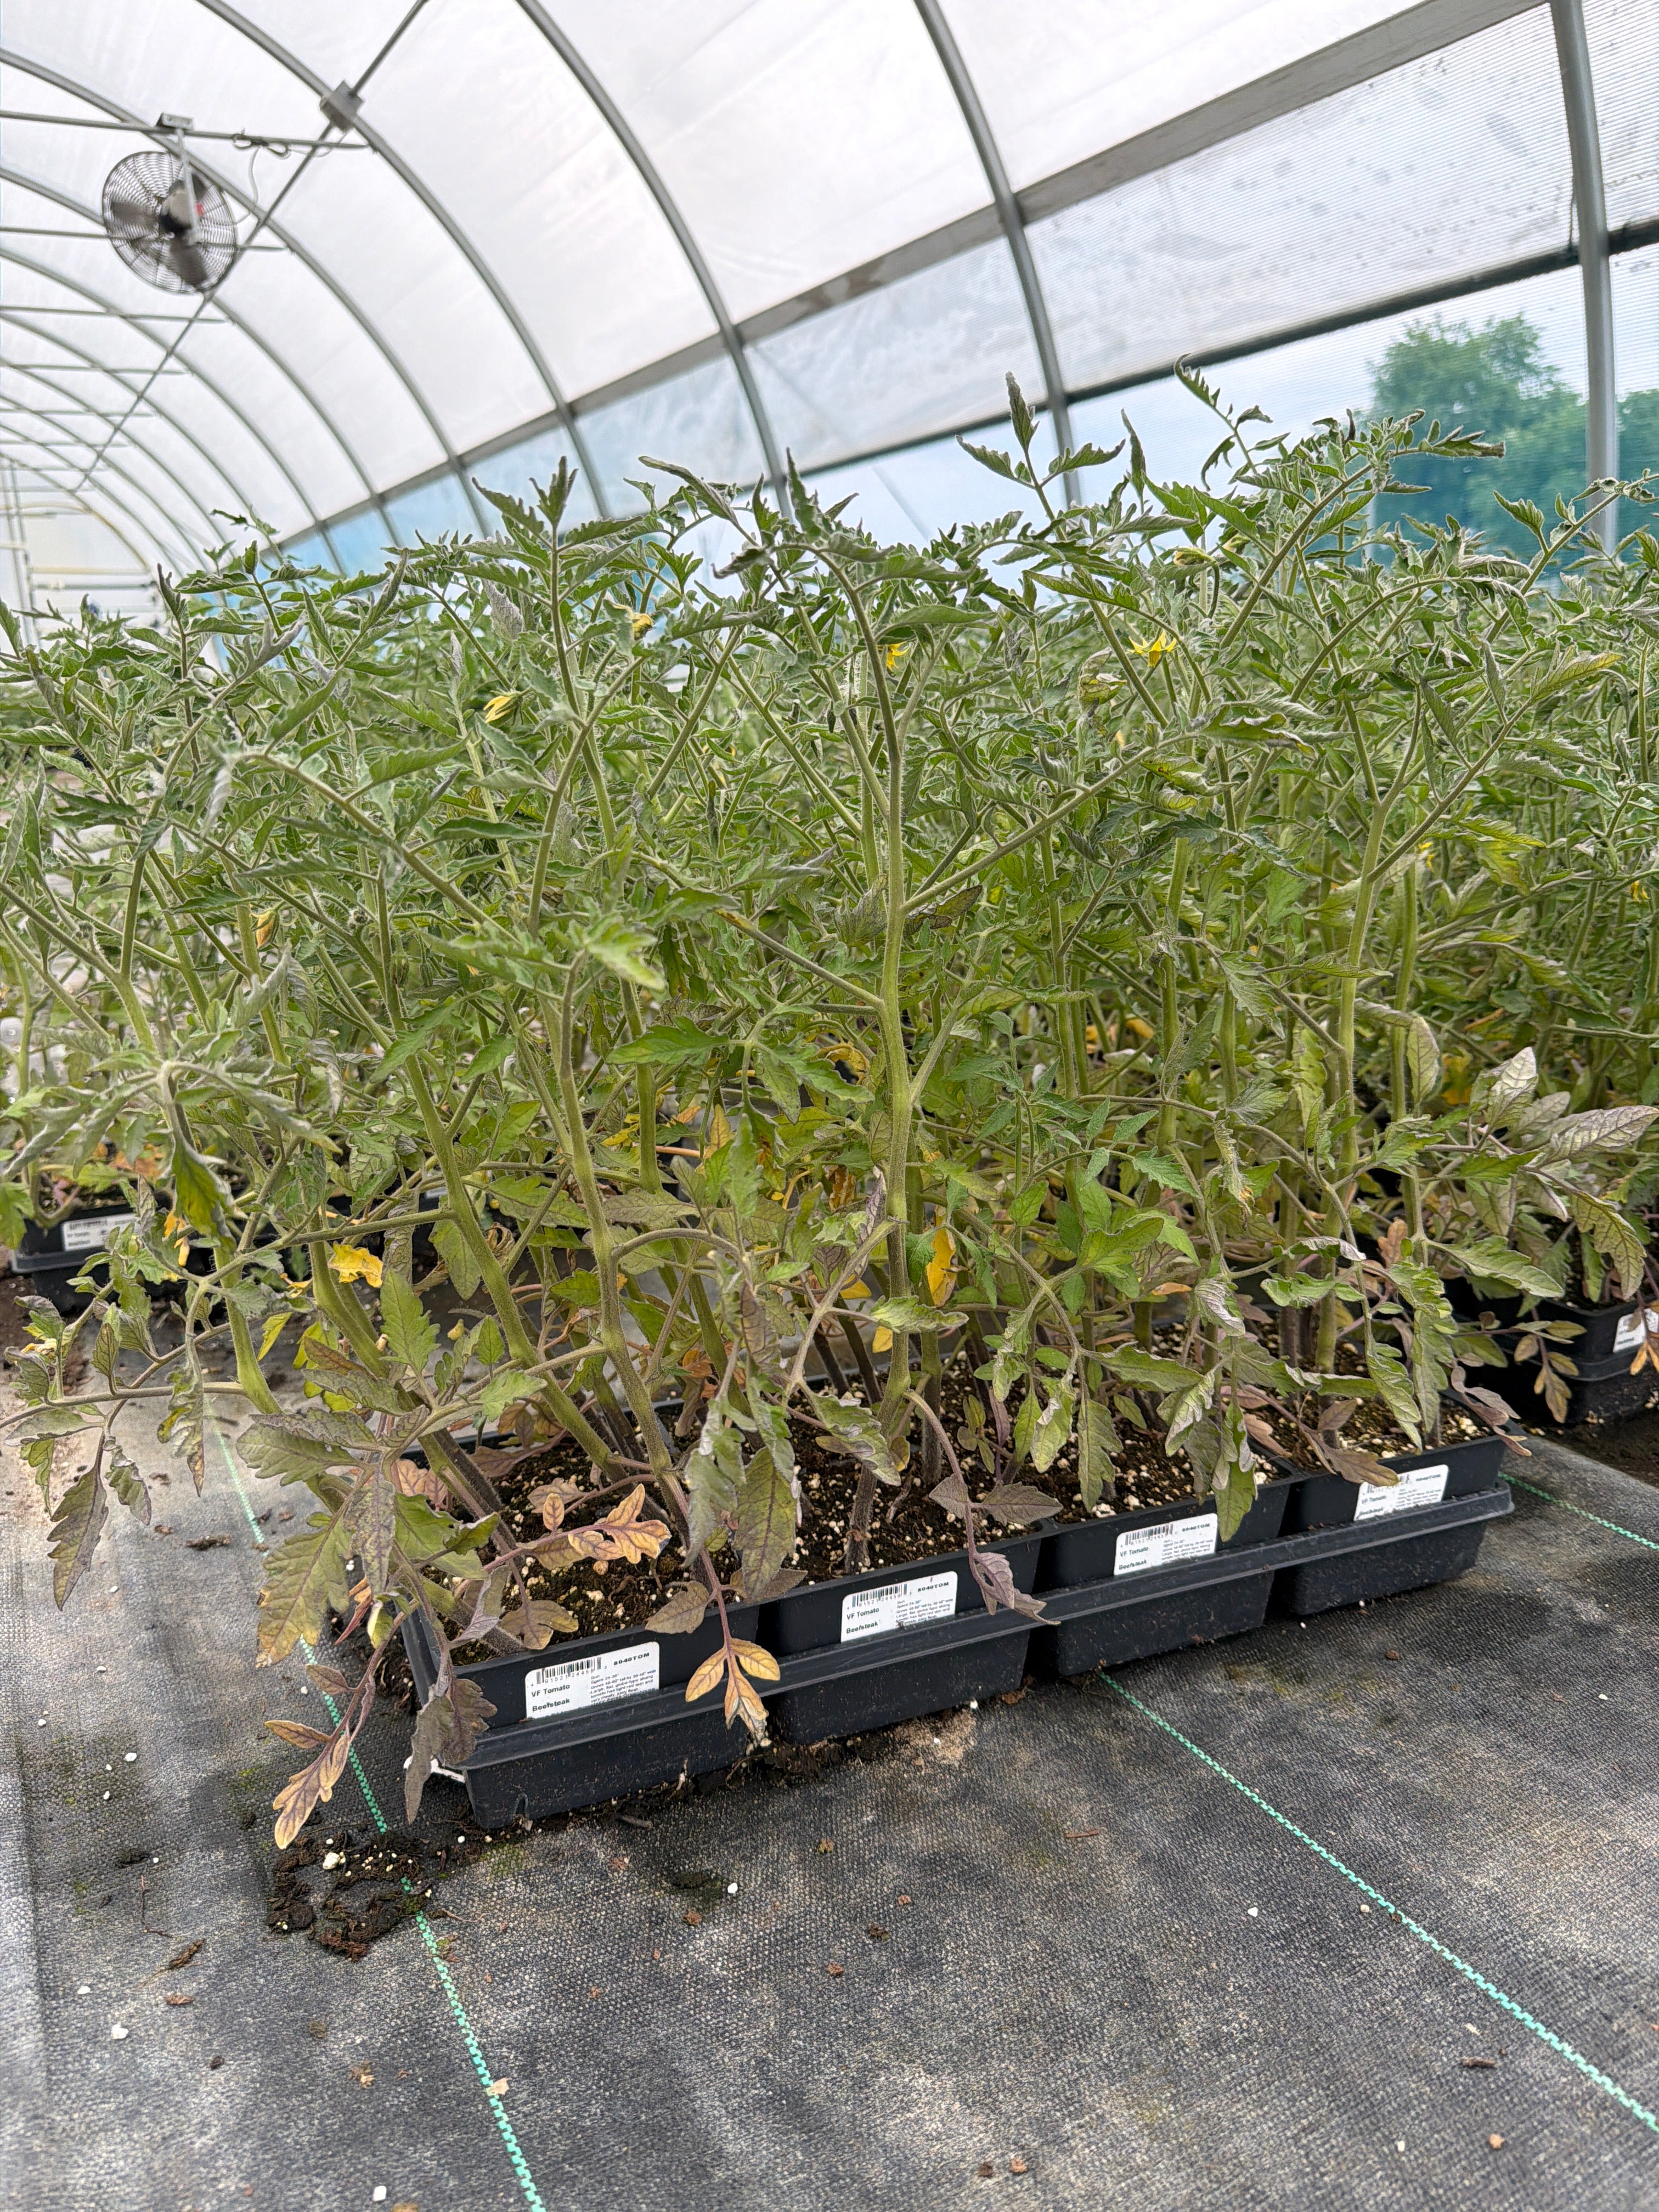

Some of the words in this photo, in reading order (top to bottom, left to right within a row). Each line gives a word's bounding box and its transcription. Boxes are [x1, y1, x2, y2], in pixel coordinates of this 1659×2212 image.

[1129, 1547, 1149, 1555] Tomato
[856, 1608, 879, 1617] Tomato
[846, 1621, 878, 1634] Beefsteak
[614, 1652, 650, 1666] 8040TOM
[545, 1675, 568, 1683] 91521
[543, 1684, 571, 1695] Tomato
[532, 1698, 571, 1712] Beefsteak
